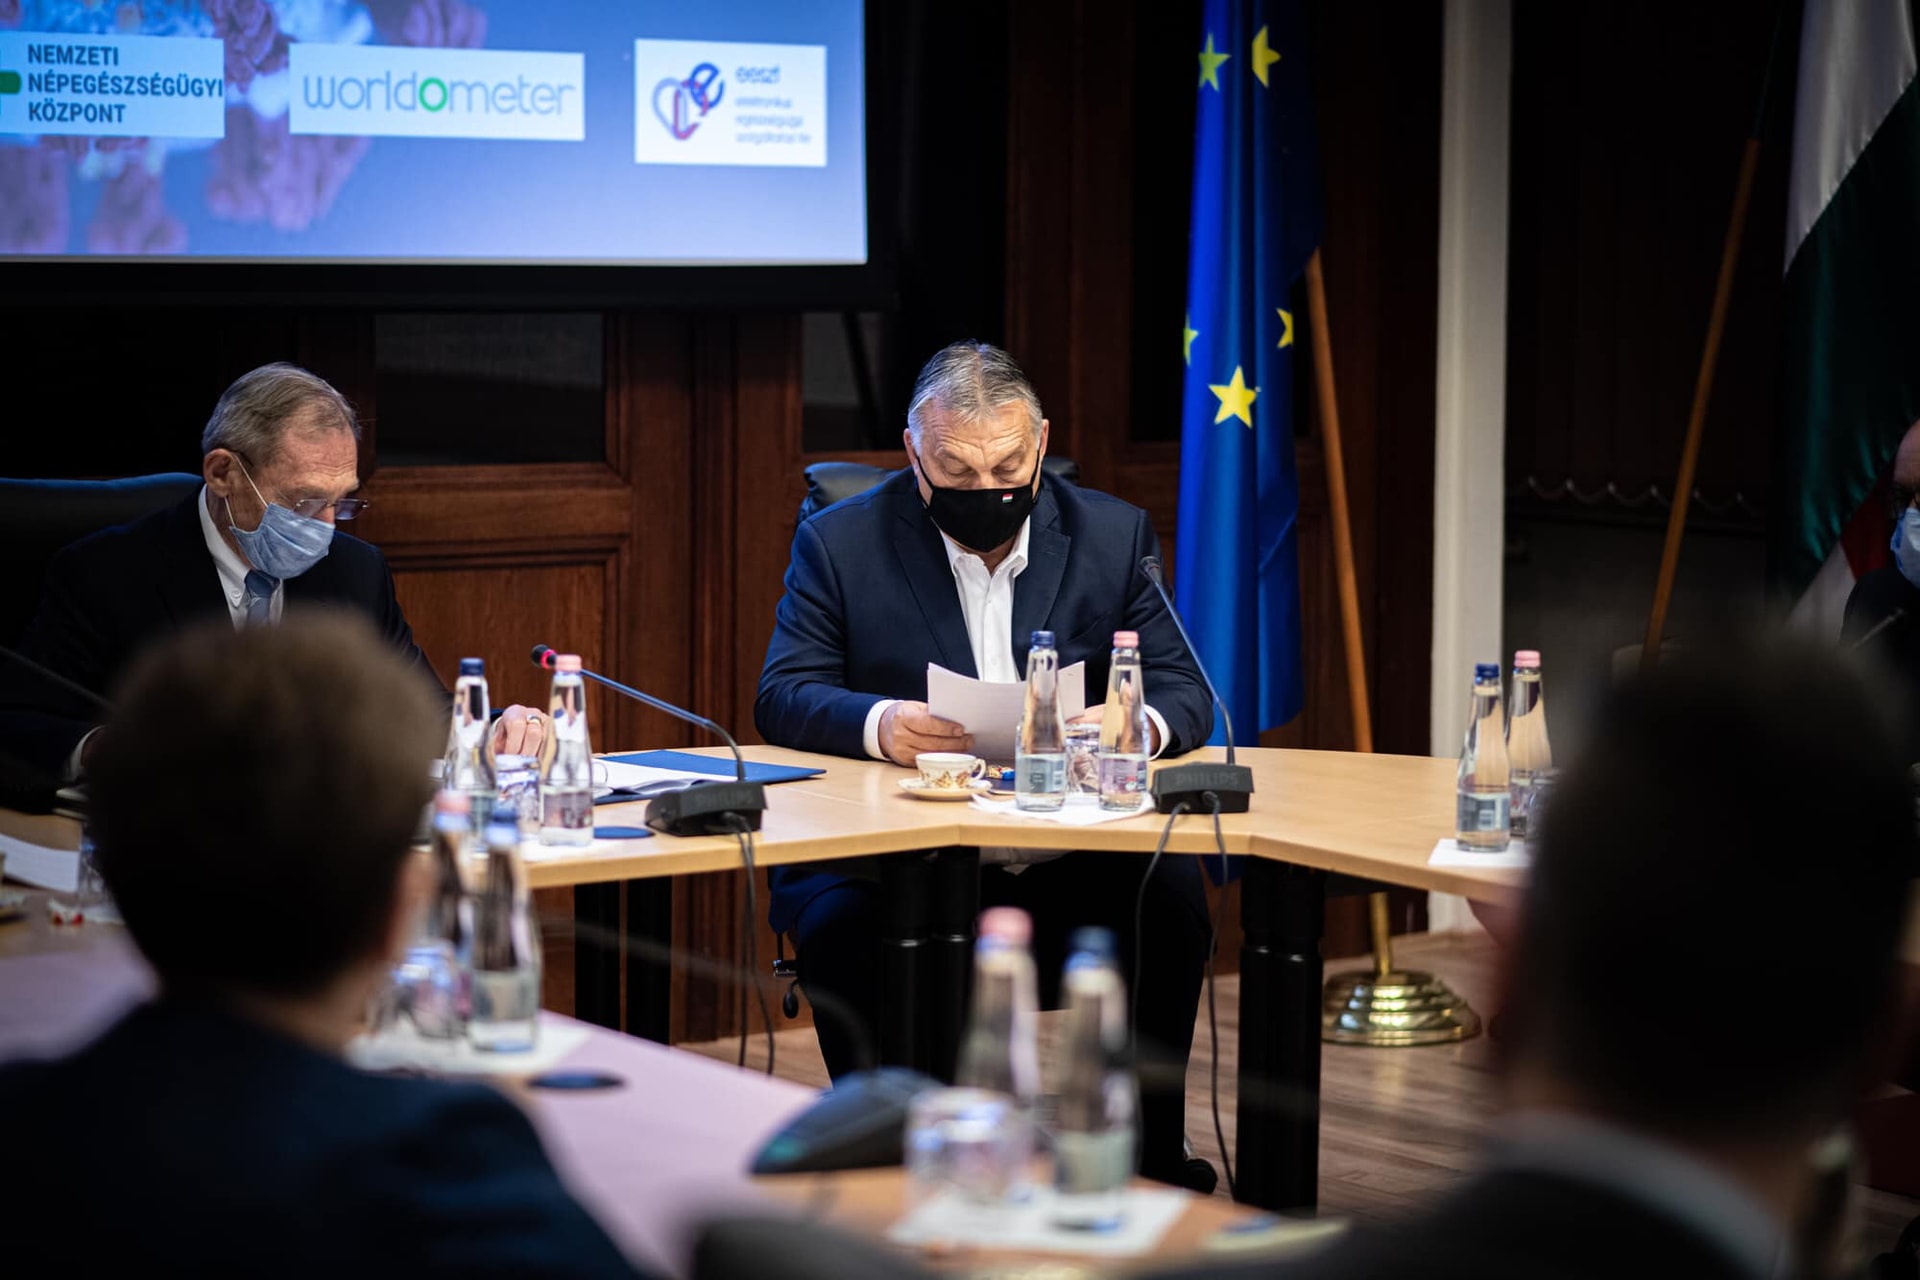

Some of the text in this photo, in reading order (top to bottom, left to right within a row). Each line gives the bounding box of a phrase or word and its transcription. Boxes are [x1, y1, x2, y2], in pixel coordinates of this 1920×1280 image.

[27, 44, 119, 66] NEMZETI
[27, 69, 223, 98] NÉPEGÉSZSÉGÜGYI
[303, 70, 576, 115] worldometer
[28, 98, 127, 123] KÖZPONT
